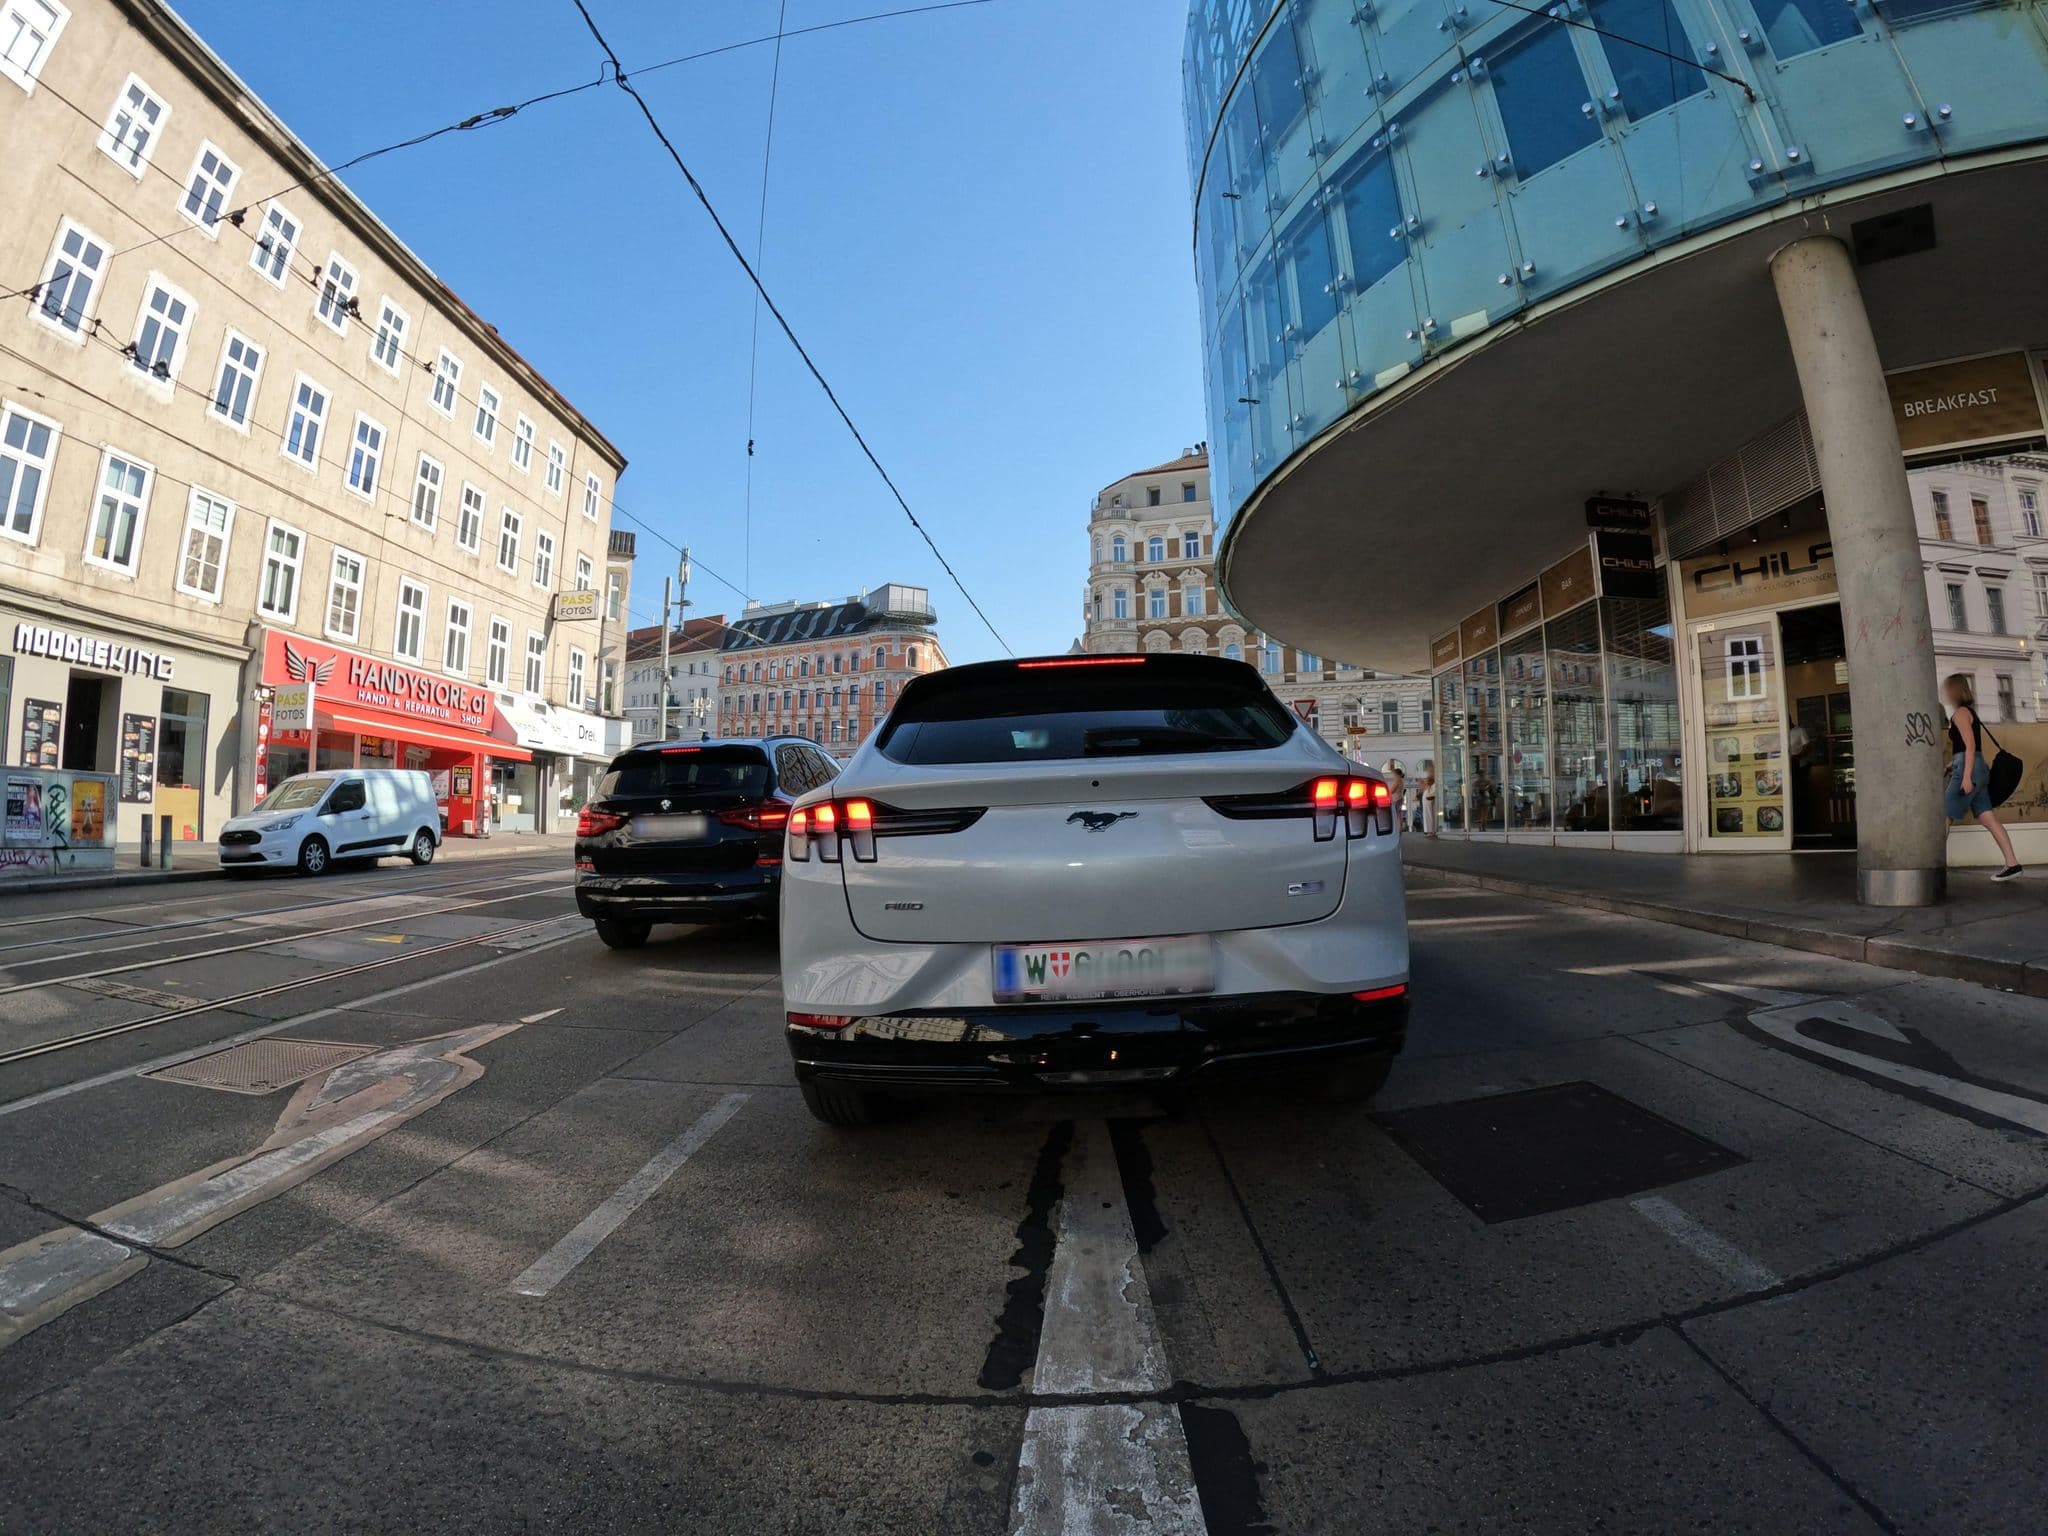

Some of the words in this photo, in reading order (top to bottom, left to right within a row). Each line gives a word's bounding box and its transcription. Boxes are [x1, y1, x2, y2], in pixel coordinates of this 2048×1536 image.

[1903, 388, 1998, 417] BREAKFAST
[561, 594, 593, 606] PASS
[276, 692, 306, 706] PASS
[358, 690, 391, 706] HANDY
[394, 698, 401, 708] &
[404, 701, 451, 719] REPARATUR
[461, 713, 482, 726] SHOP
[453, 767, 472, 775] PASS
[885, 903, 924, 911] AWD
[1024, 953, 1047, 985] W
